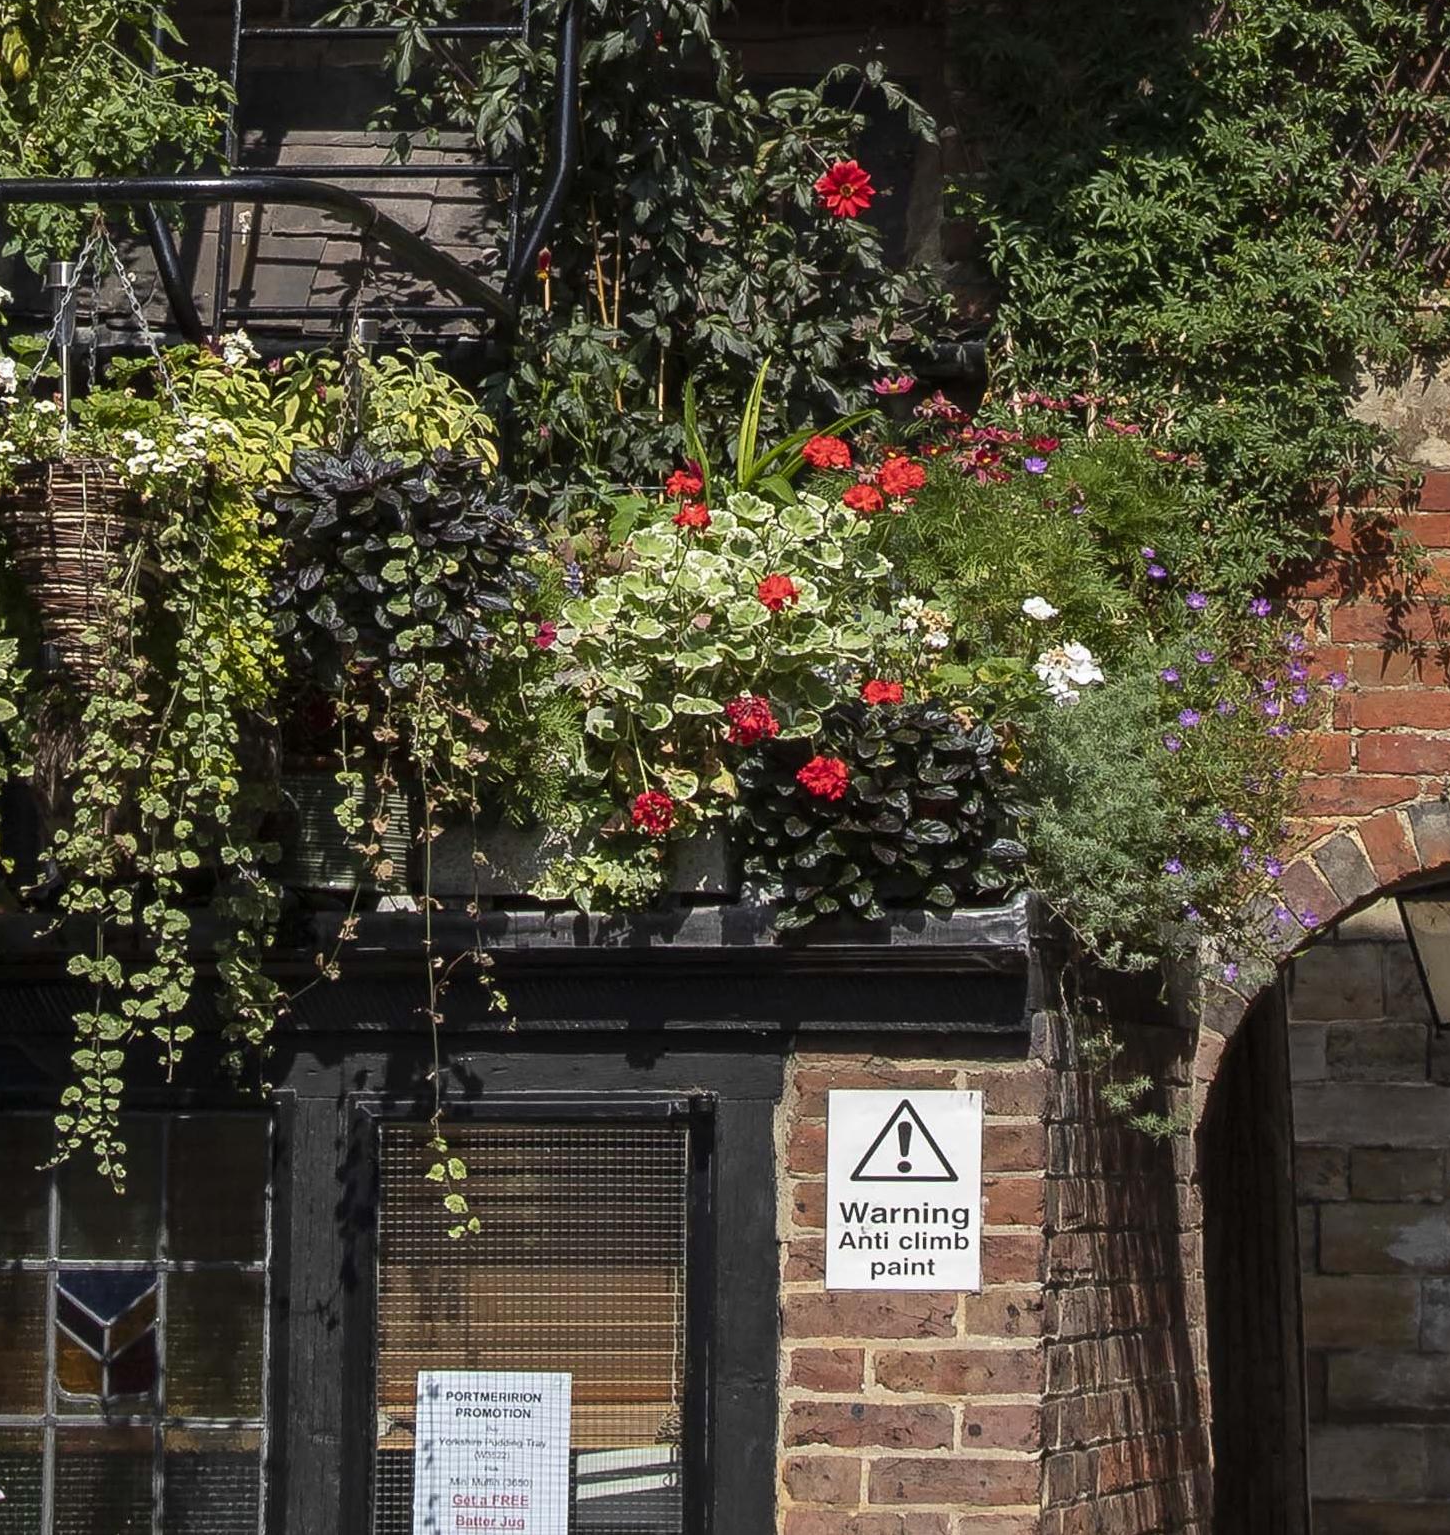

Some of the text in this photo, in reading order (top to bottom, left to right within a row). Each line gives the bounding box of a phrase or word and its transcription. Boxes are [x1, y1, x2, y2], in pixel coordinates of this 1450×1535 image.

[839, 1202, 970, 1230] Warning
[838, 1232, 970, 1250] Anti climb
[871, 1257, 936, 1281] paint
[455, 1407, 531, 1419] PROMOTION
[439, 1437, 482, 1446] Yorkshire
[452, 1494, 476, 1506] Get
[492, 1494, 529, 1507] FREE
[455, 1515, 525, 1530] Batter Jug
